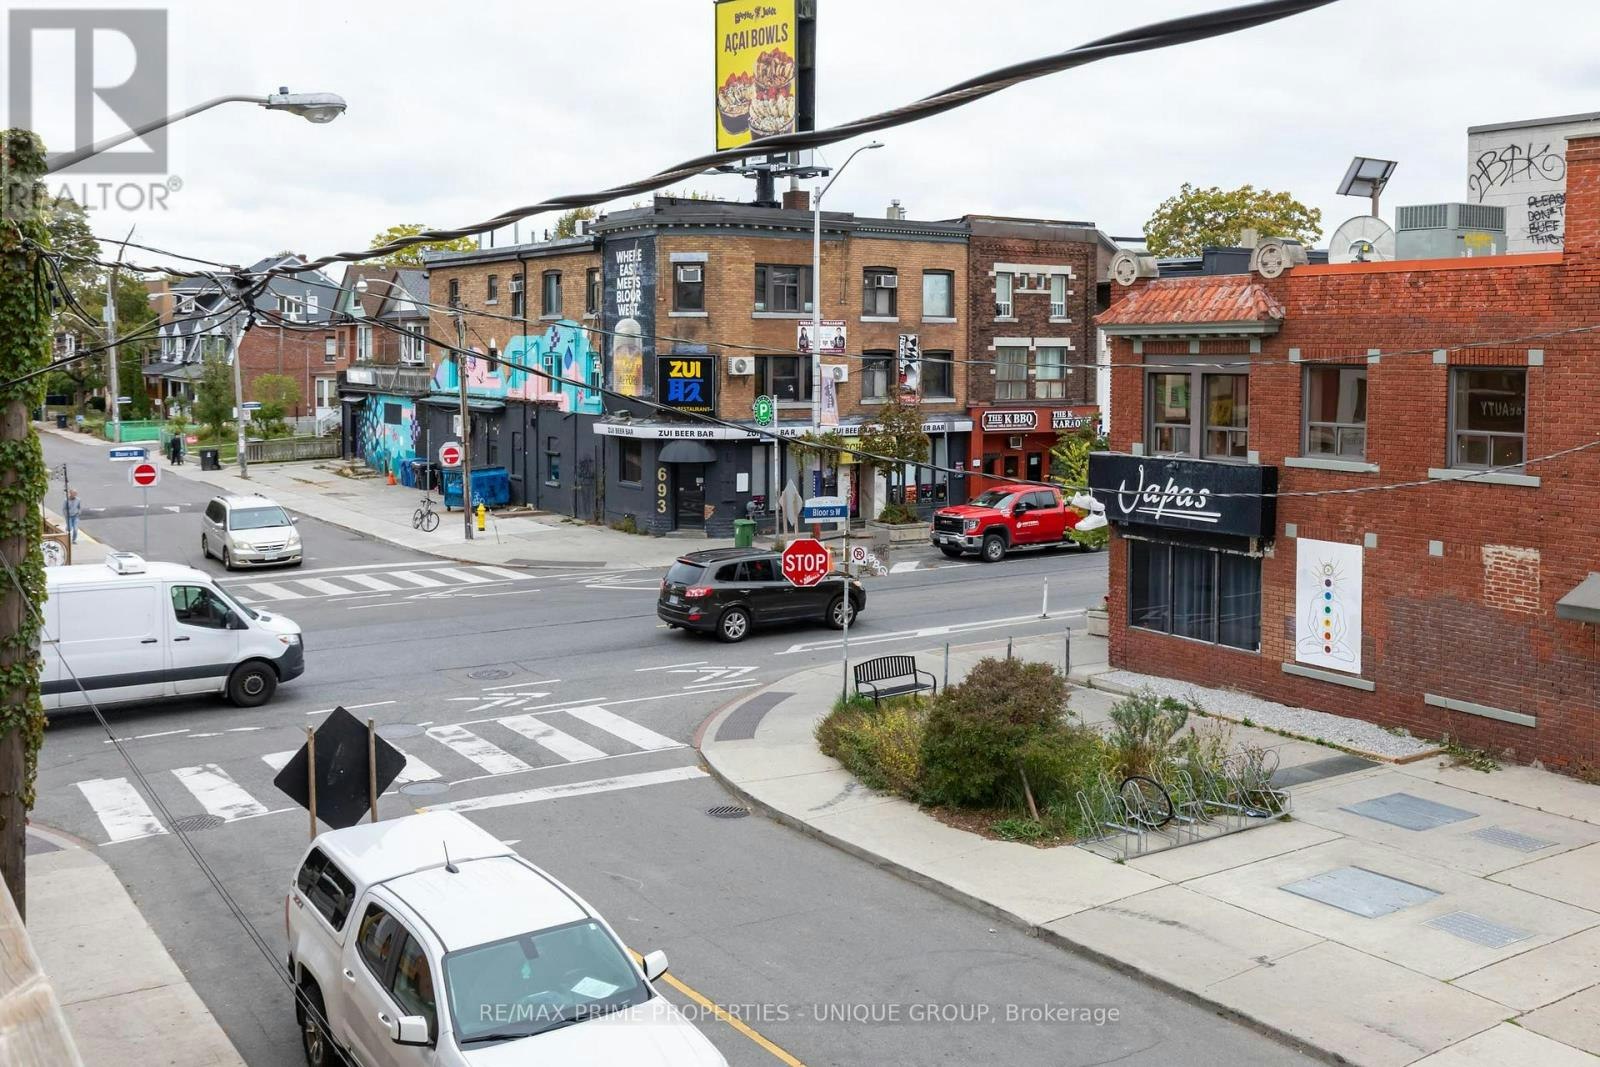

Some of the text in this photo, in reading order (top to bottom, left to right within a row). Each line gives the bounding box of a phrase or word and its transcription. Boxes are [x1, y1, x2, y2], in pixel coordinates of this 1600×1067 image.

[724, 23, 788, 56] AÇAI BOWLS
[616, 290, 641, 303] BLOOR
[669, 360, 701, 378] ZUI
[987, 413, 1033, 425] THE K BBQ
[1067, 410, 1073, 418] K
[607, 426, 615, 434] ZUI
[615, 427, 625, 435] BEER
[780, 429, 797, 437] BAR
[657, 467, 667, 513] 693
[1117, 464, 1211, 520] Japas
[812, 508, 829, 517] Bloor
[835, 508, 841, 516] W
[785, 553, 826, 571] STOP
